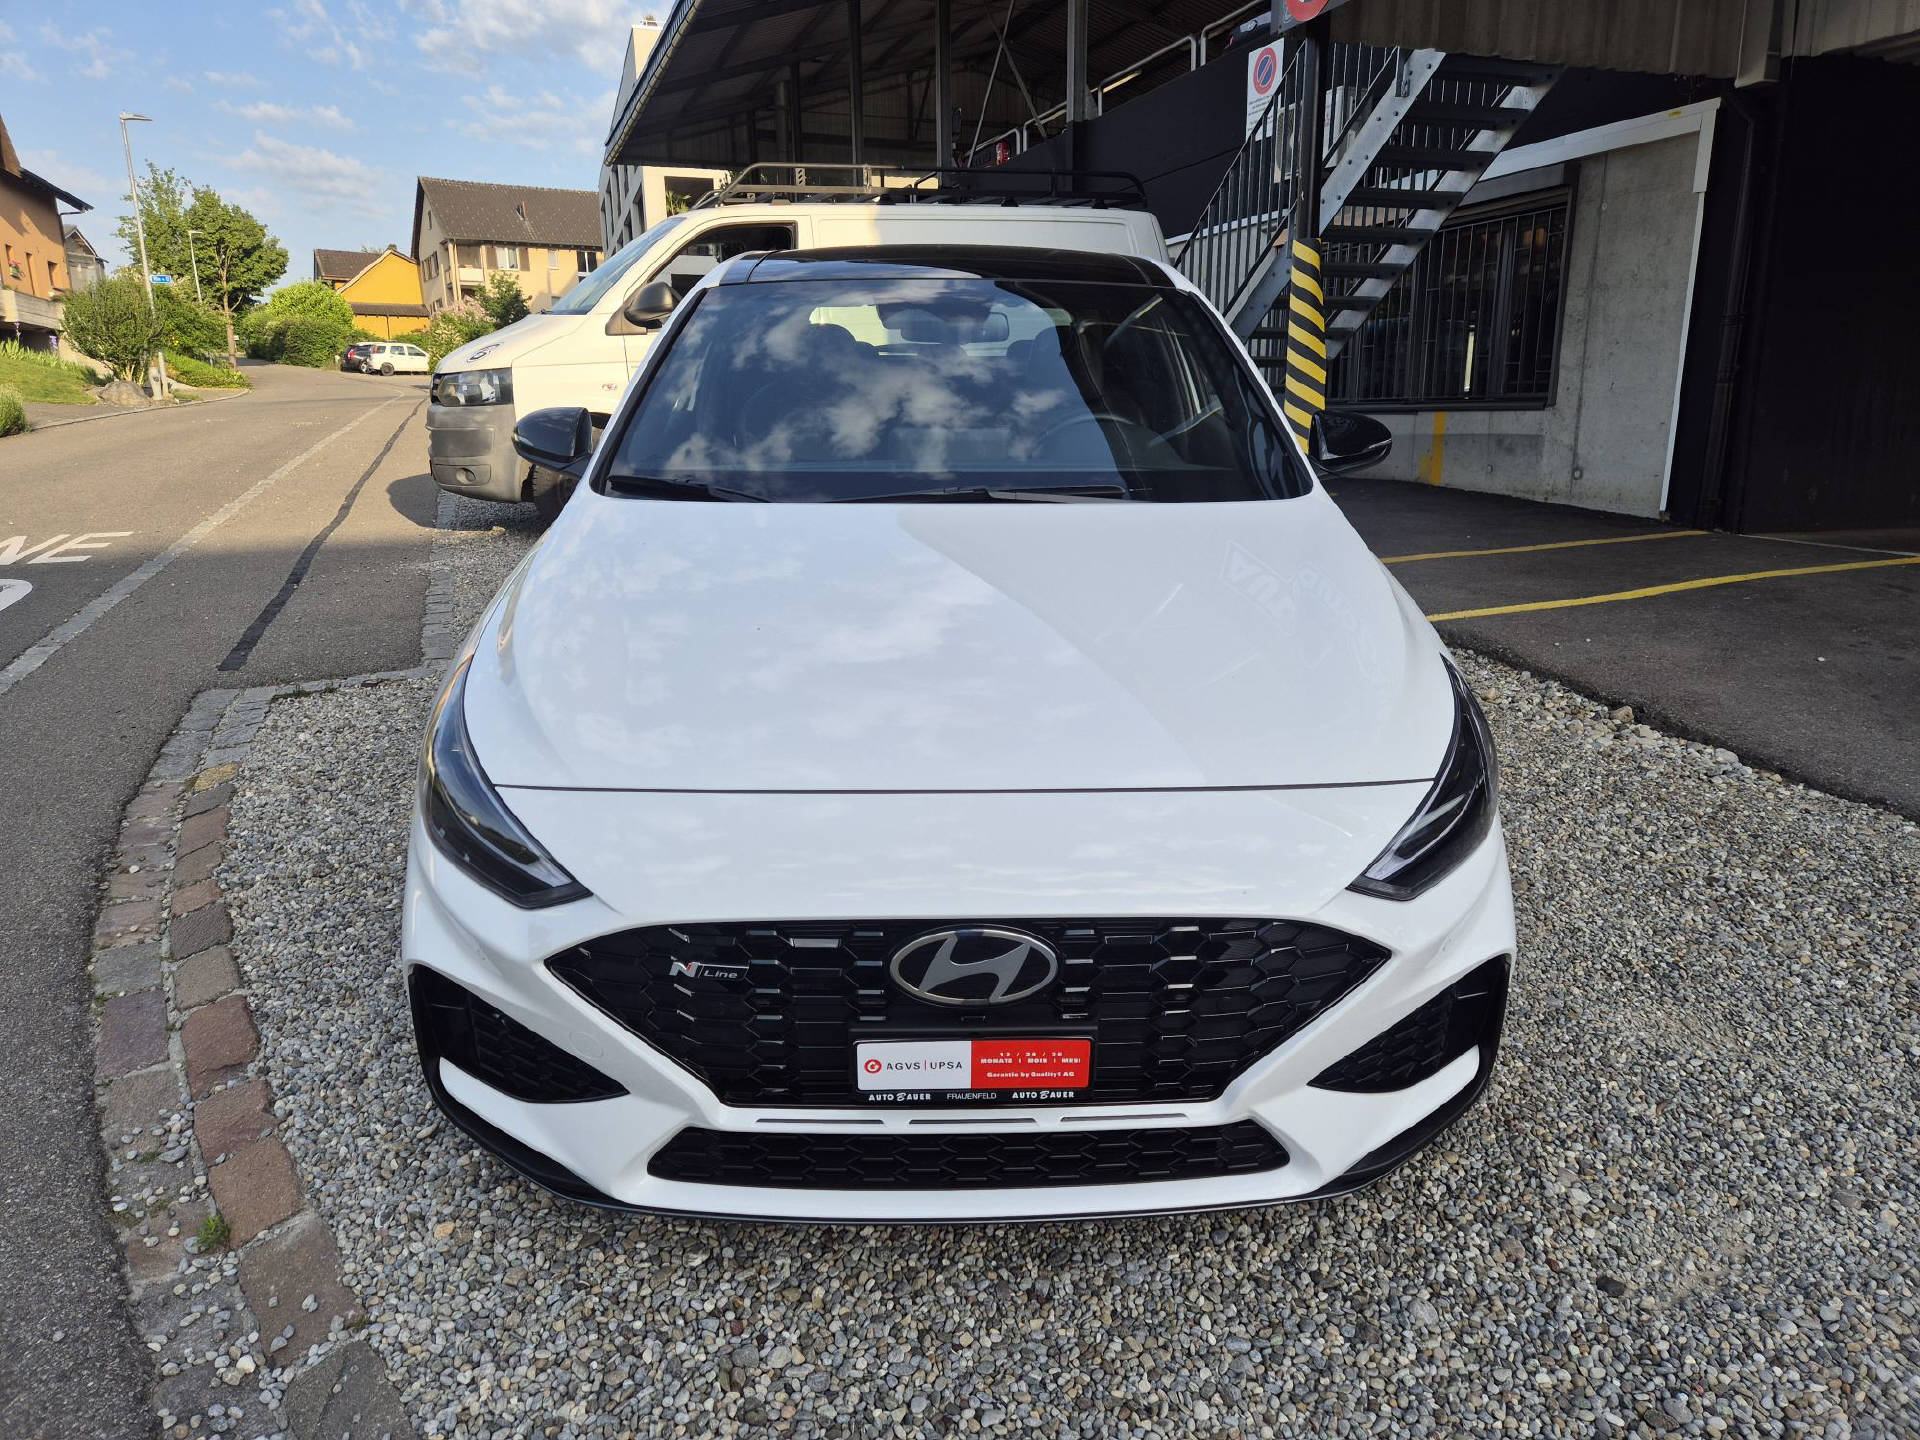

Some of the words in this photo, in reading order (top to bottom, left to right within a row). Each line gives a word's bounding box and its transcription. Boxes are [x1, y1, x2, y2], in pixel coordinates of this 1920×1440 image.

[669, 961, 700, 978] N
[704, 970, 738, 979] Line
[886, 1062, 921, 1071] AGVS
[930, 1061, 963, 1070] UPSA
[896, 1092, 931, 1102] BAUER
[946, 1092, 997, 1100] FRAUENFELD
[1012, 1091, 1038, 1099] AUTO
[1039, 1090, 1075, 1100] BAUER
